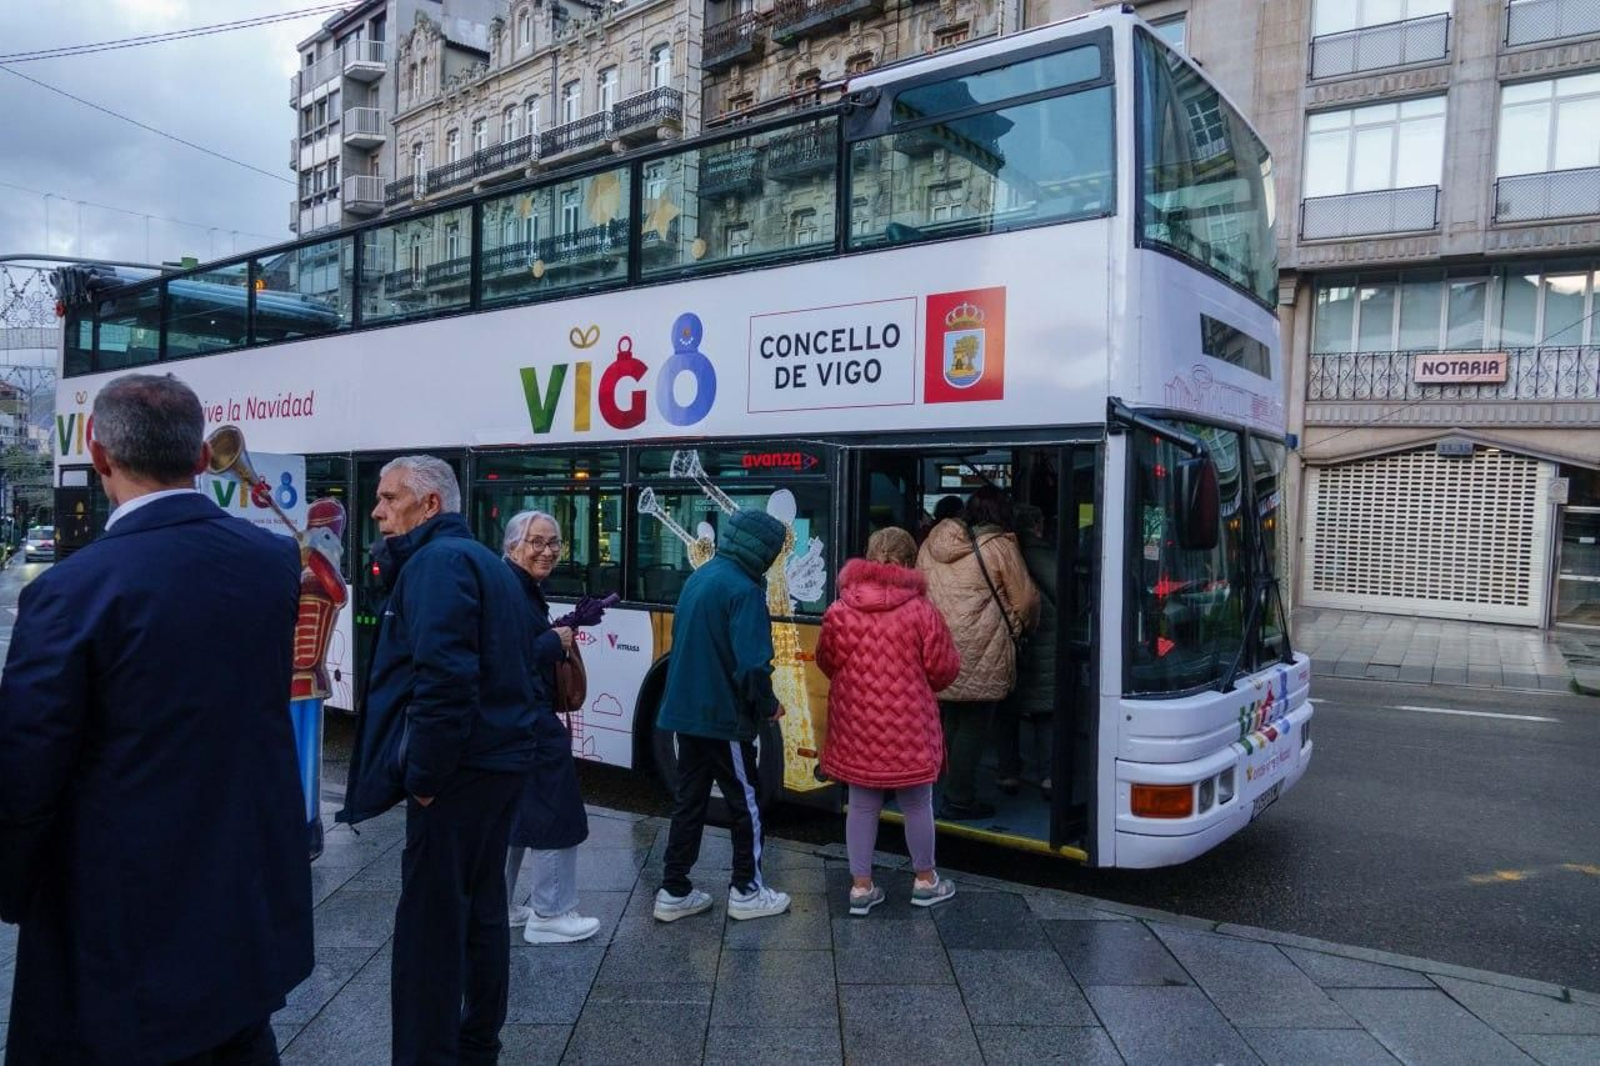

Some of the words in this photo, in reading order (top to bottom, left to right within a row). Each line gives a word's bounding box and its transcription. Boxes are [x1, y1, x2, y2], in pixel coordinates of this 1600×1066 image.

[760, 323, 901, 359] CONCELLO
[519, 312, 717, 434] VIGO
[775, 365, 807, 389] DE
[817, 358, 882, 386] VIGO
[1421, 360, 1500, 376] NOTARIA
[203, 401, 223, 422] ive
[227, 397, 241, 421] la
[245, 389, 314, 421] Navidad
[56, 390, 96, 456] VI
[742, 452, 801, 469] avanza
